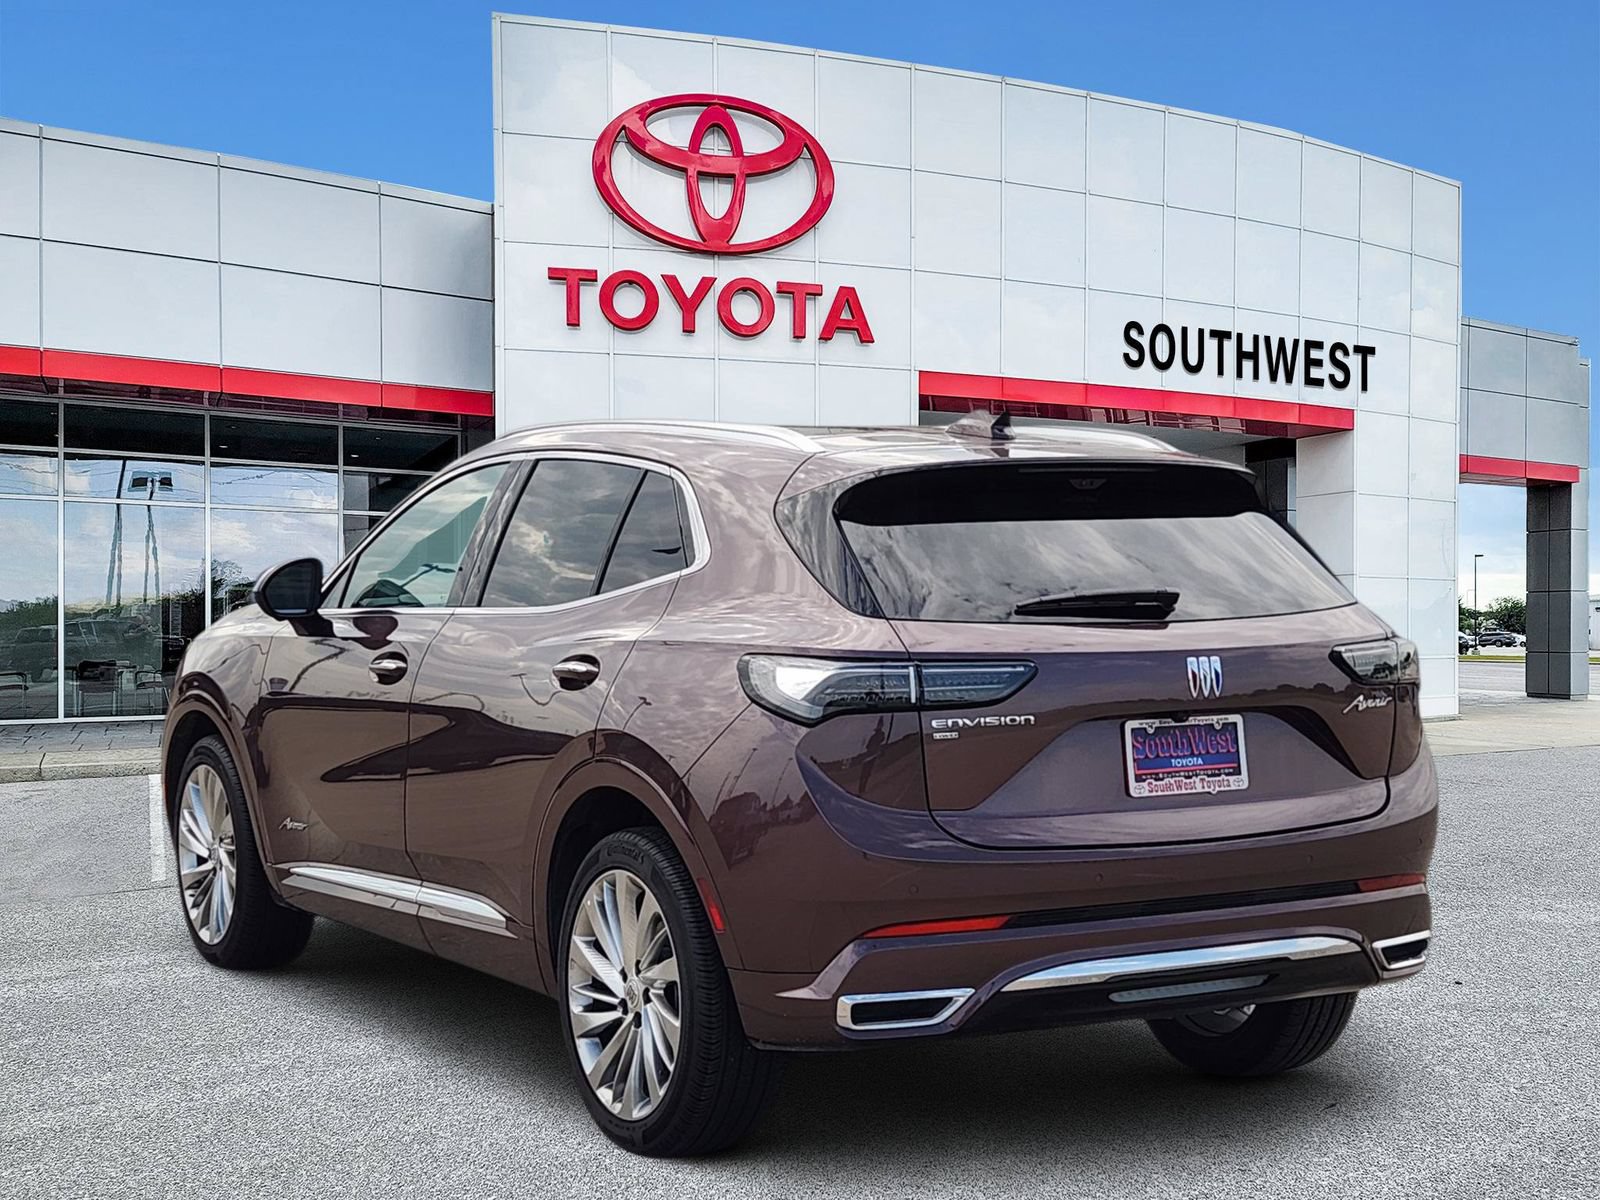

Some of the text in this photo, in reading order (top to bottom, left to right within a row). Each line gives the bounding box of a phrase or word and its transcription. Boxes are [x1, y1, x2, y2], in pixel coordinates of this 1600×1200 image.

[547, 266, 875, 344] TOYOTA
[1122, 320, 1376, 393] SOUTHWEST
[931, 715, 1035, 729] ENVISION
[1171, 757, 1204, 768] TOYOTA
[1147, 777, 1232, 793] SouthWest Toyota
